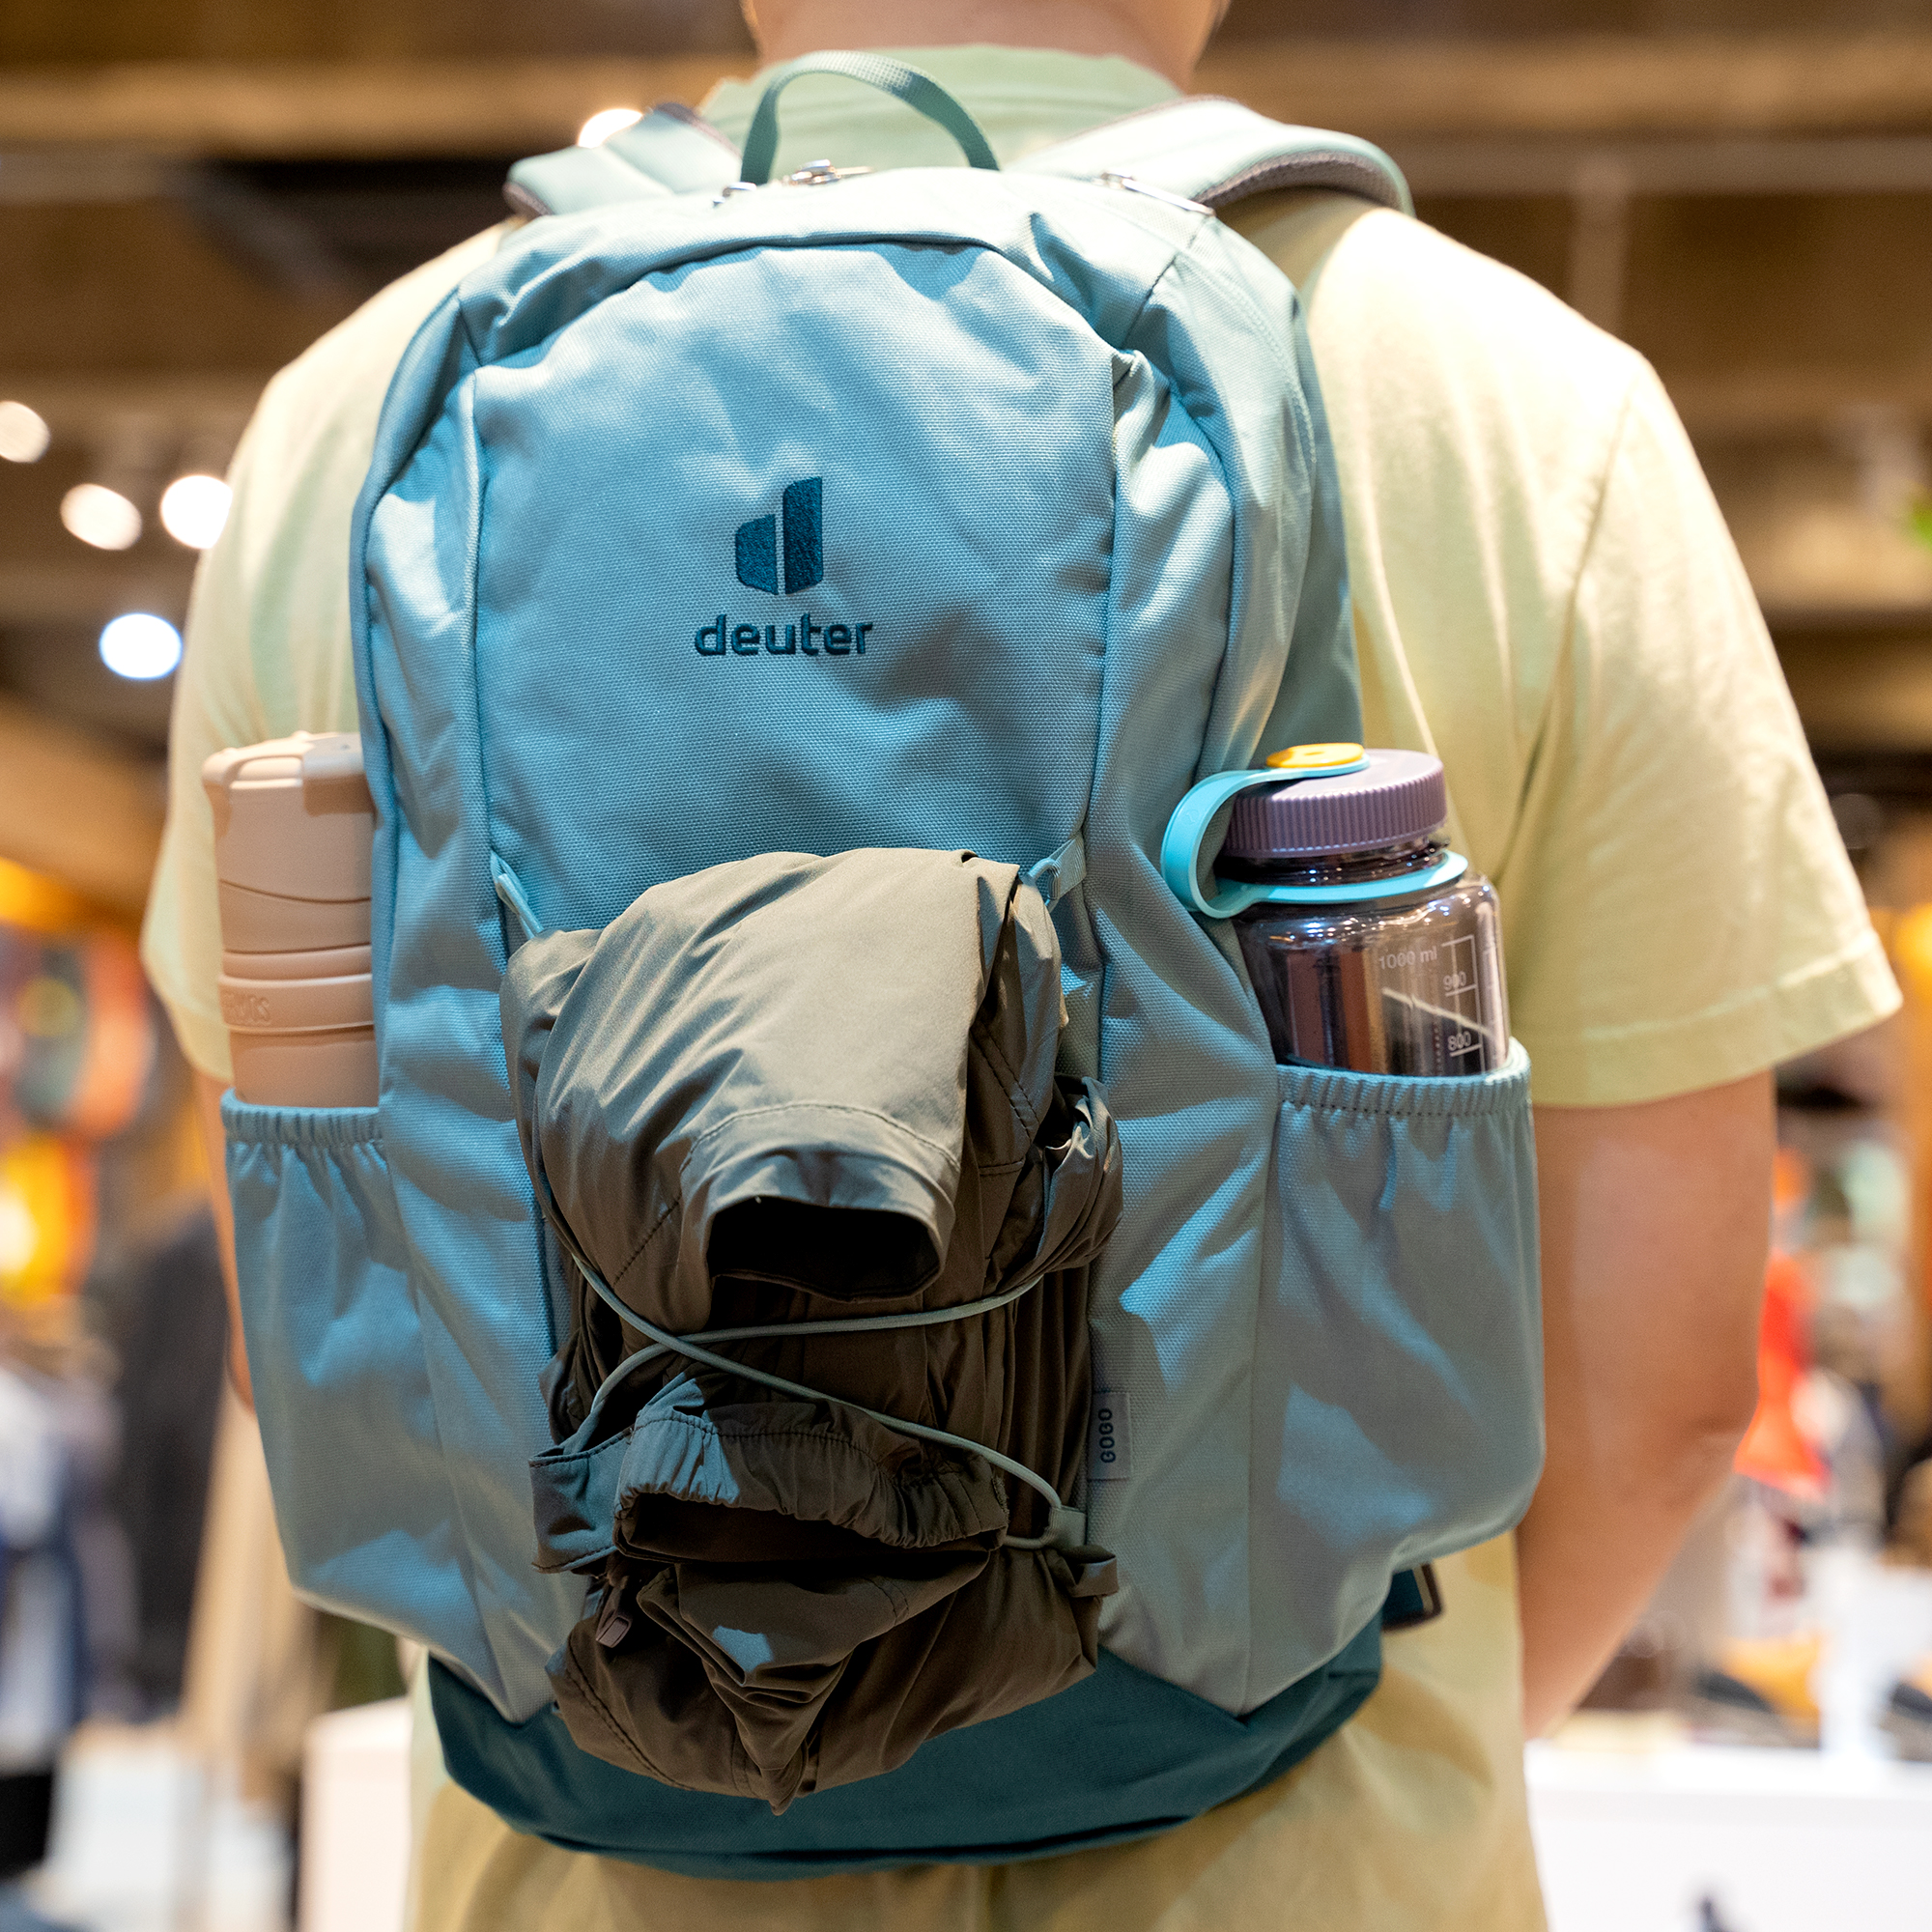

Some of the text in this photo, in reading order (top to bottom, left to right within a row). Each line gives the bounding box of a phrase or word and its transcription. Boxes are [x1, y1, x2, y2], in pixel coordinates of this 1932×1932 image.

[695, 613, 873, 656] deuter
[1379, 946, 1437, 969] 1000 ml
[1442, 971, 1466, 990] 900
[1448, 1031, 1471, 1051] 800
[1098, 1408, 1116, 1463] GOGO
